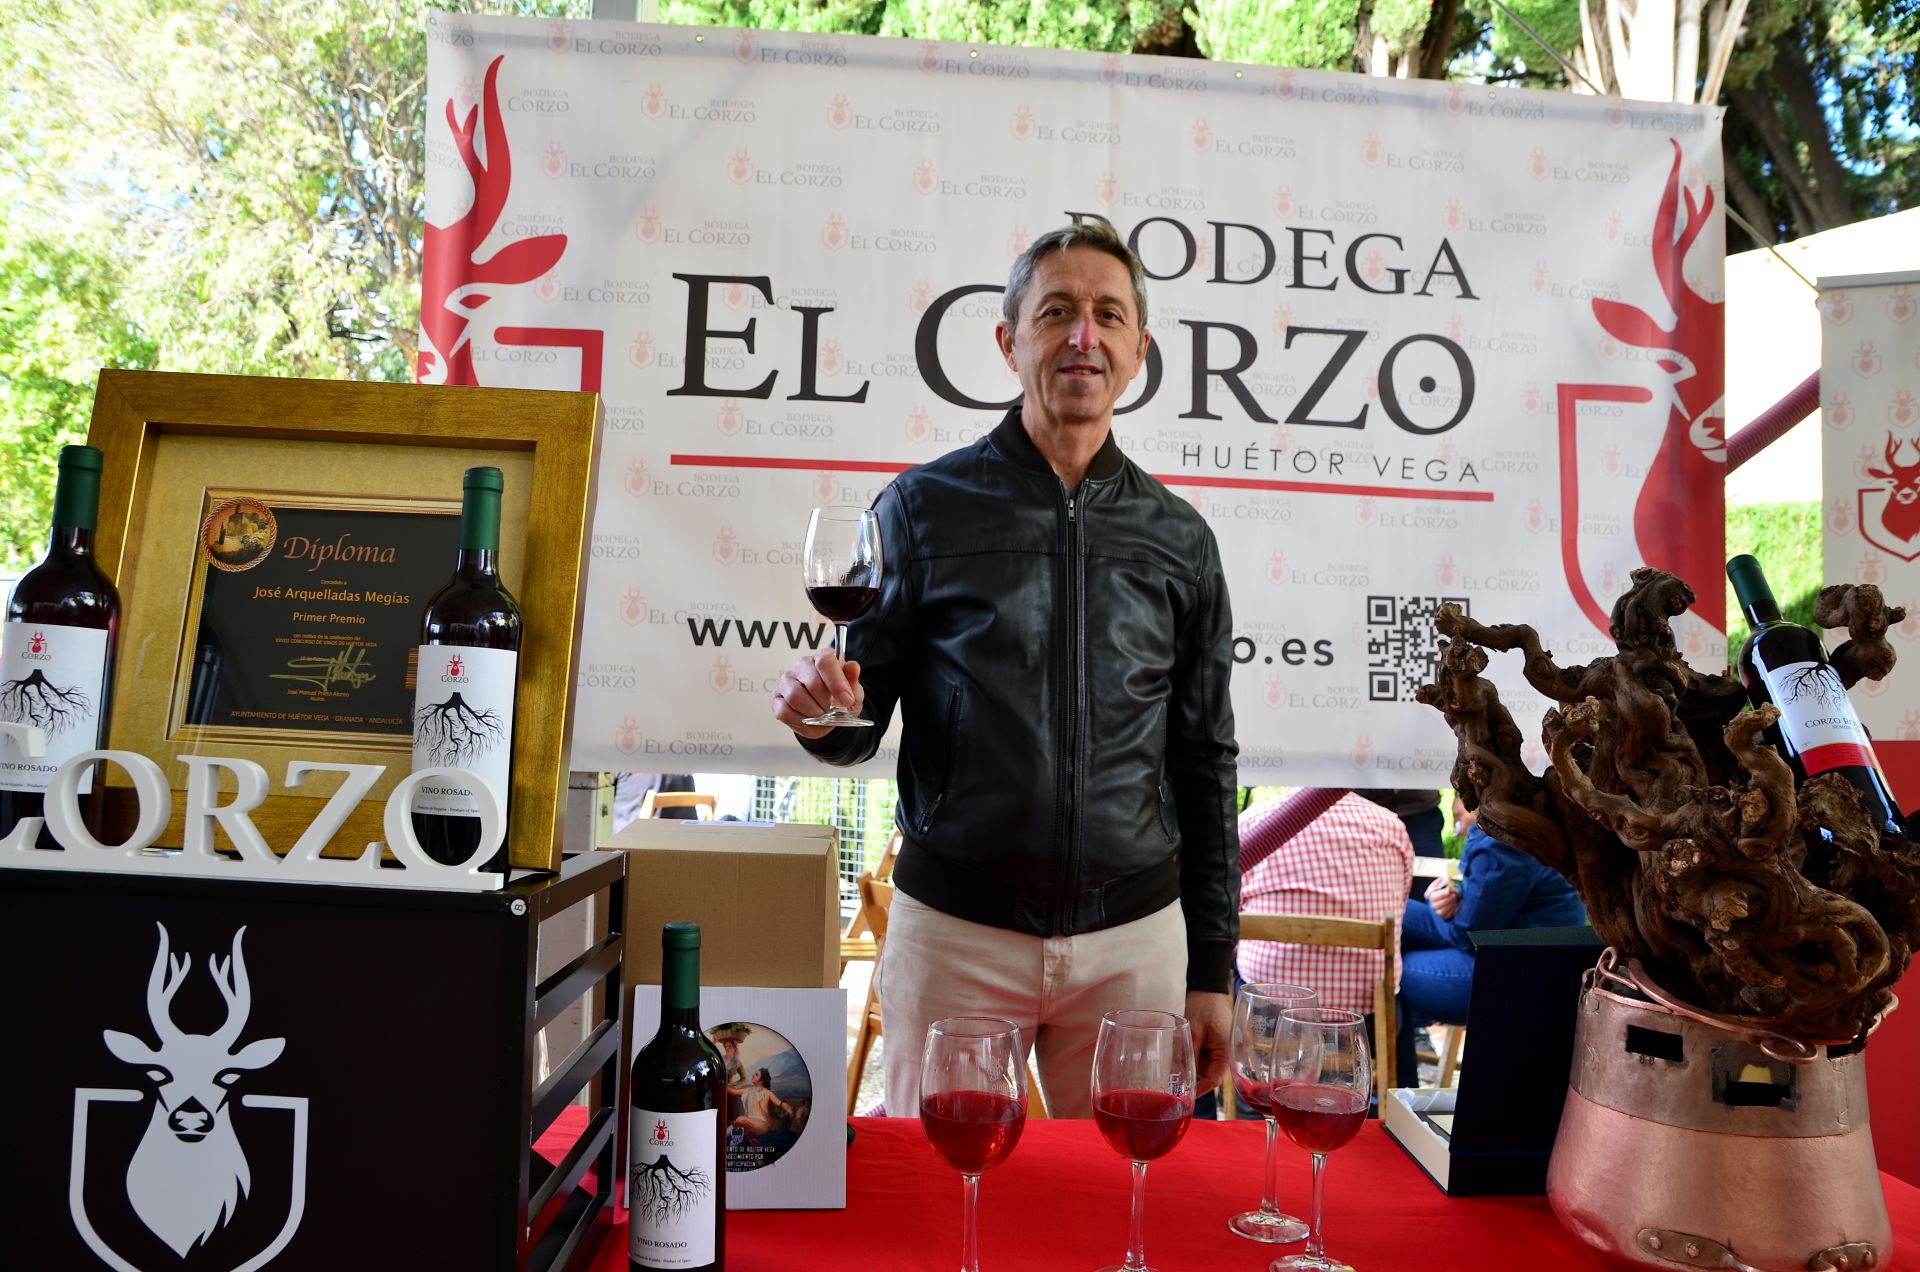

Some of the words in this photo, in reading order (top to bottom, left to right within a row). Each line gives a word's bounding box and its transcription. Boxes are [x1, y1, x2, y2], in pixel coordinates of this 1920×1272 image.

[1183, 442, 1344, 475] HUÉTOR
[1372, 456, 1480, 483] VEGA
[283, 534, 397, 572] Diploma
[253, 586, 281, 599] José
[285, 587, 360, 602] Arquelladas
[365, 591, 410, 606] Megías
[293, 612, 327, 622] Primer
[330, 613, 366, 624] Premio
[687, 618, 826, 650] www
[21, 652, 51, 661] CORZO
[1232, 637, 1334, 666] o.es
[441, 674, 469, 684] CORZO
[230, 711, 277, 719] AYUNTAMIENTO
[278, 712, 287, 720] DE
[1805, 717, 1841, 728] CORZO
[17, 763, 58, 772] ROSADO
[421, 786, 439, 795] VINO
[441, 788, 473, 796] ROSAD
[649, 1138, 674, 1147] CORZO
[637, 1236, 653, 1246] VINO
